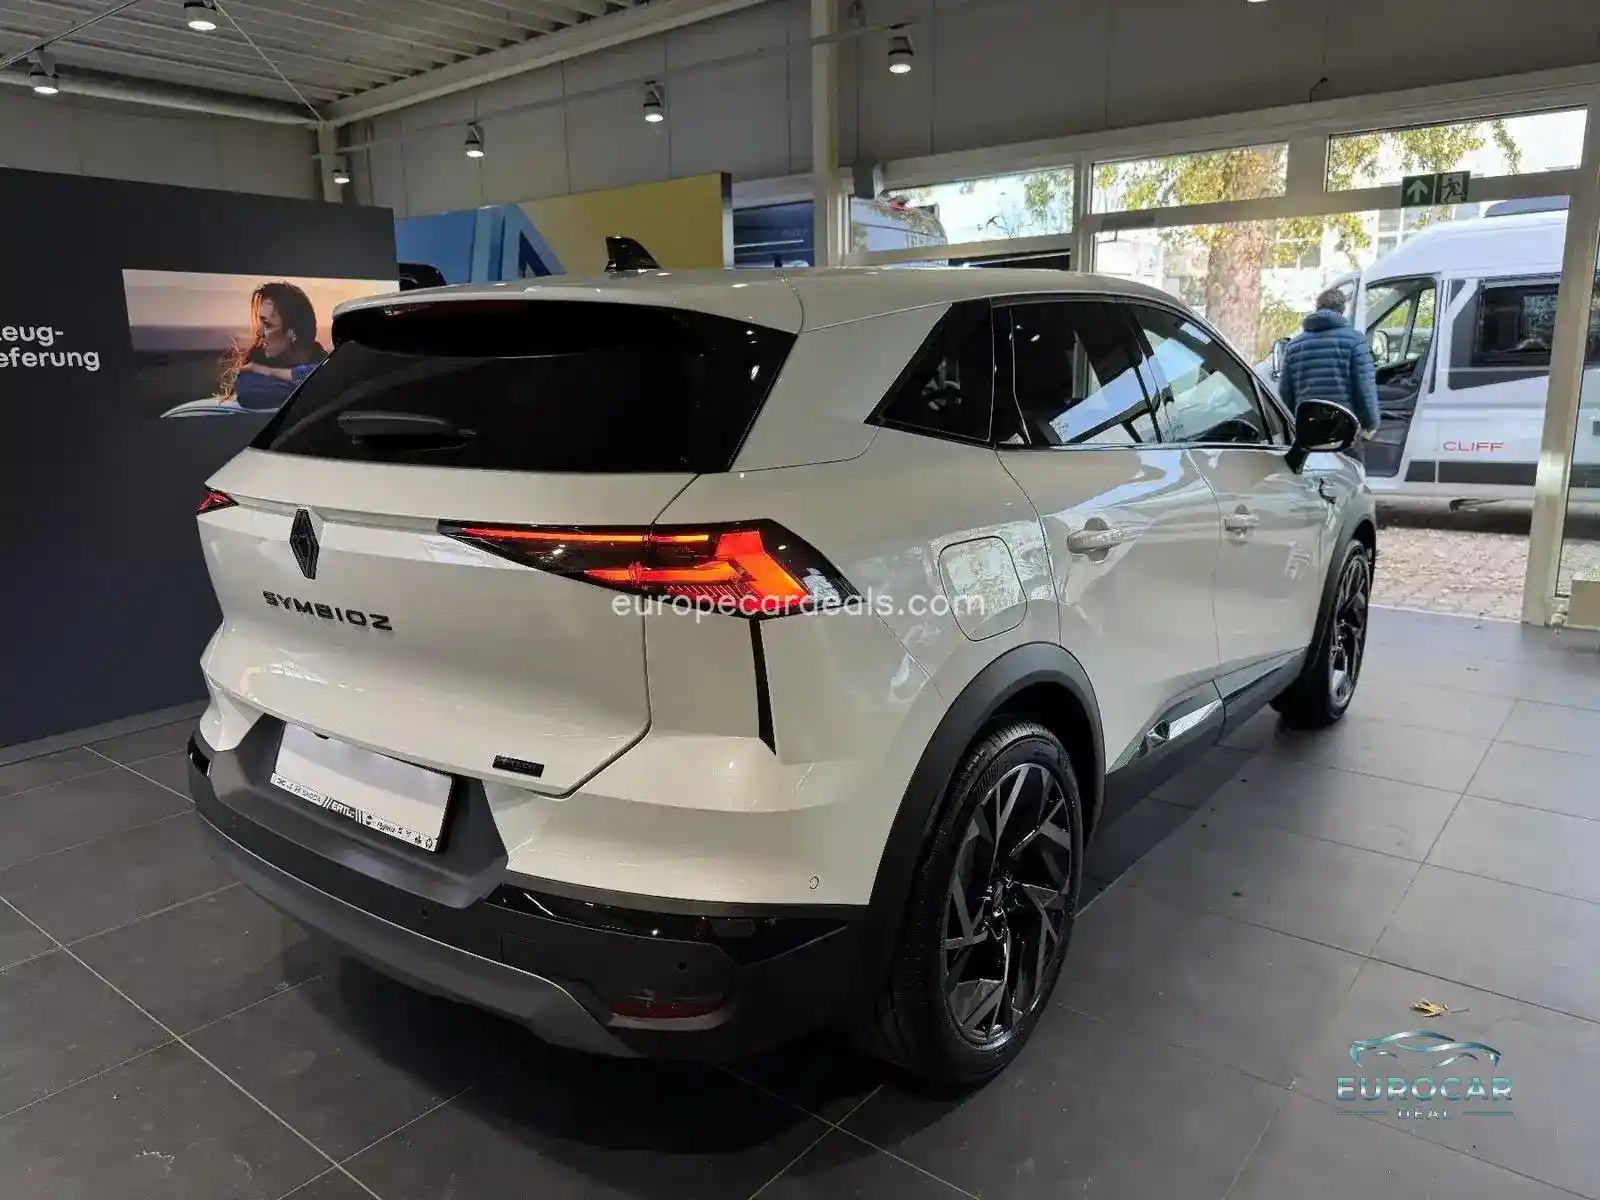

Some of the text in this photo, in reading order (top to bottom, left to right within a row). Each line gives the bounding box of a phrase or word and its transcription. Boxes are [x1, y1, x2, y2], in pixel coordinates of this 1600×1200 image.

[0, 325, 64, 347] eug-
[1443, 441, 1503, 452] CLIFF
[262, 590, 393, 631] SYMBIOZ
